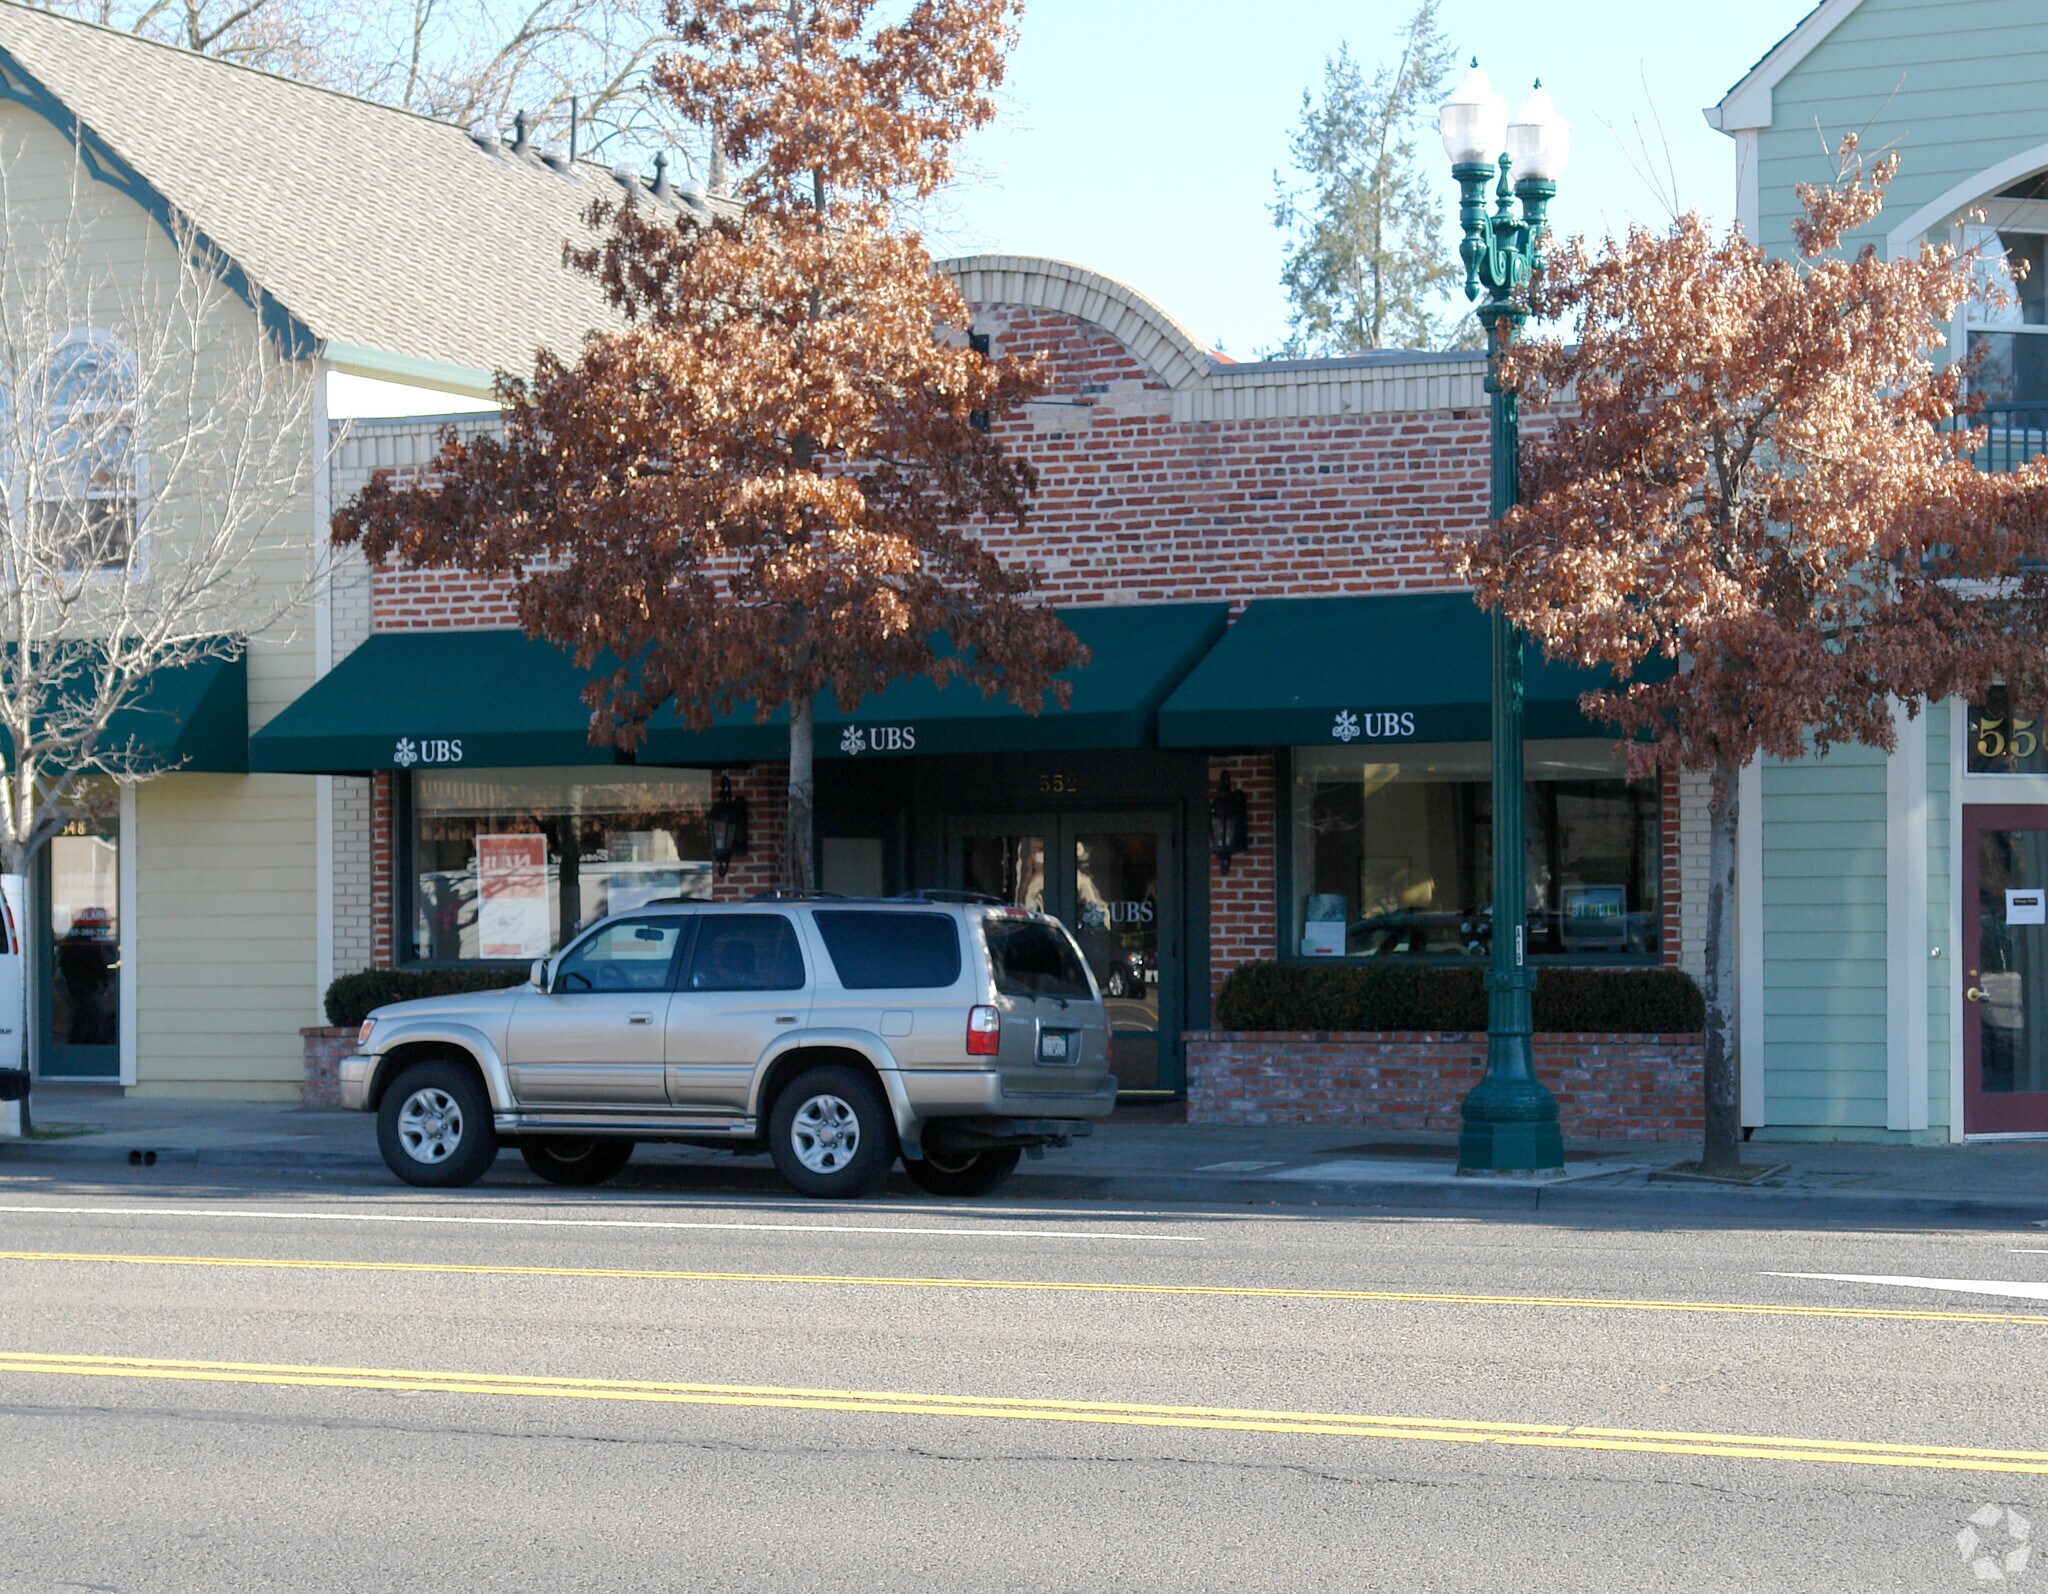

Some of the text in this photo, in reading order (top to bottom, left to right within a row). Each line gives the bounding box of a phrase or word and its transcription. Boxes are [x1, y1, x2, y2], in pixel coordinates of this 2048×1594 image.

[1364, 712, 1415, 737] UBS
[870, 726, 916, 750] UBS
[1977, 717, 2048, 757] 55
[421, 739, 463, 762] UBS
[1039, 774, 1077, 792] 552
[1110, 901, 1154, 922] UBS
